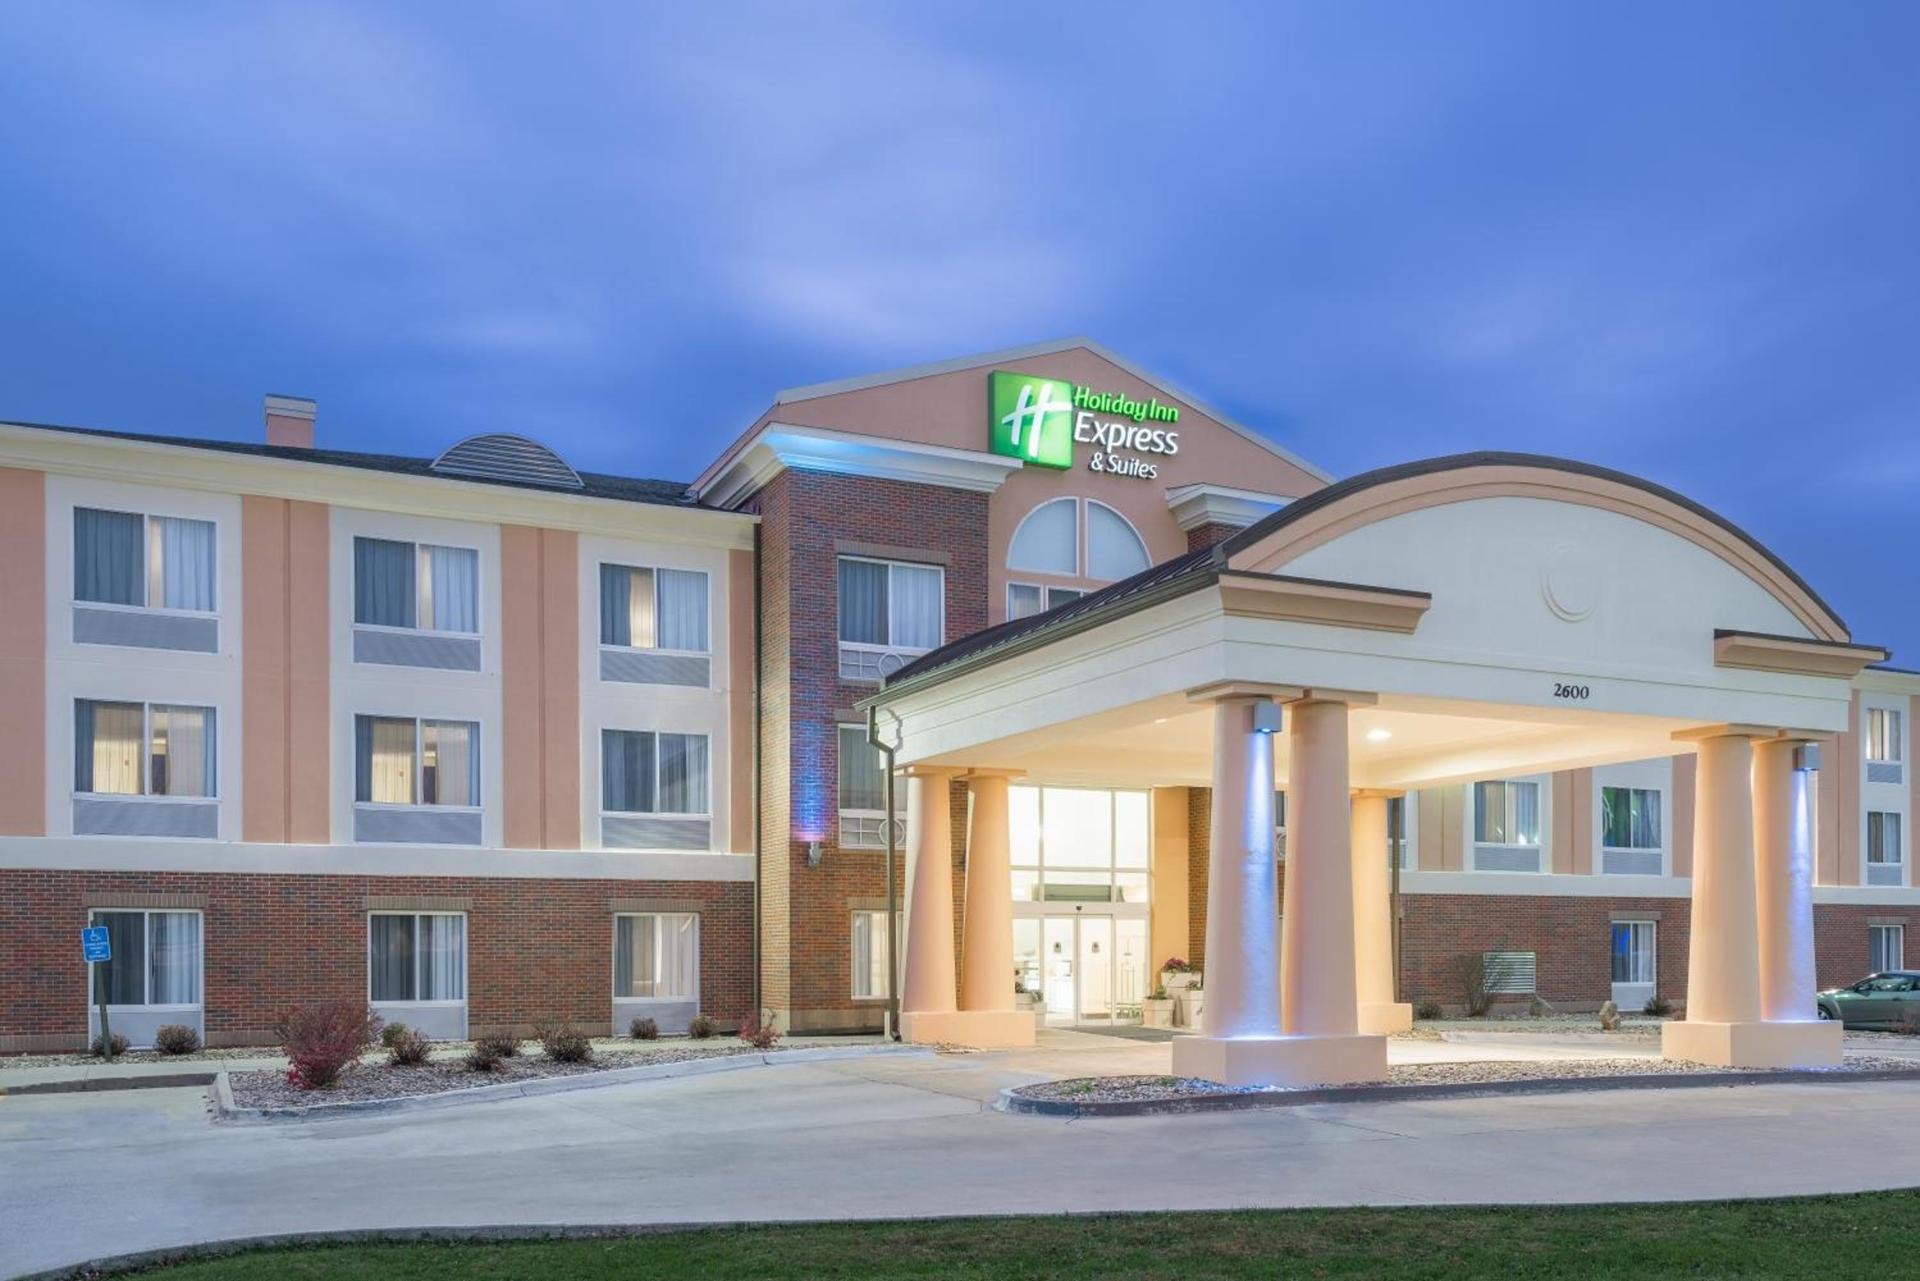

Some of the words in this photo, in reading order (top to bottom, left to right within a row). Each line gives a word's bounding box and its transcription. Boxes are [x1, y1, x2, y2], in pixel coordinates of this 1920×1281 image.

[1002, 383, 1072, 457] H
[1074, 386, 1147, 422] Holiday
[1149, 398, 1179, 422] Inn
[1074, 412, 1179, 455] Express
[1090, 452, 1103, 471] &
[1106, 455, 1158, 479] Suites
[1554, 683, 1589, 699] 2600
